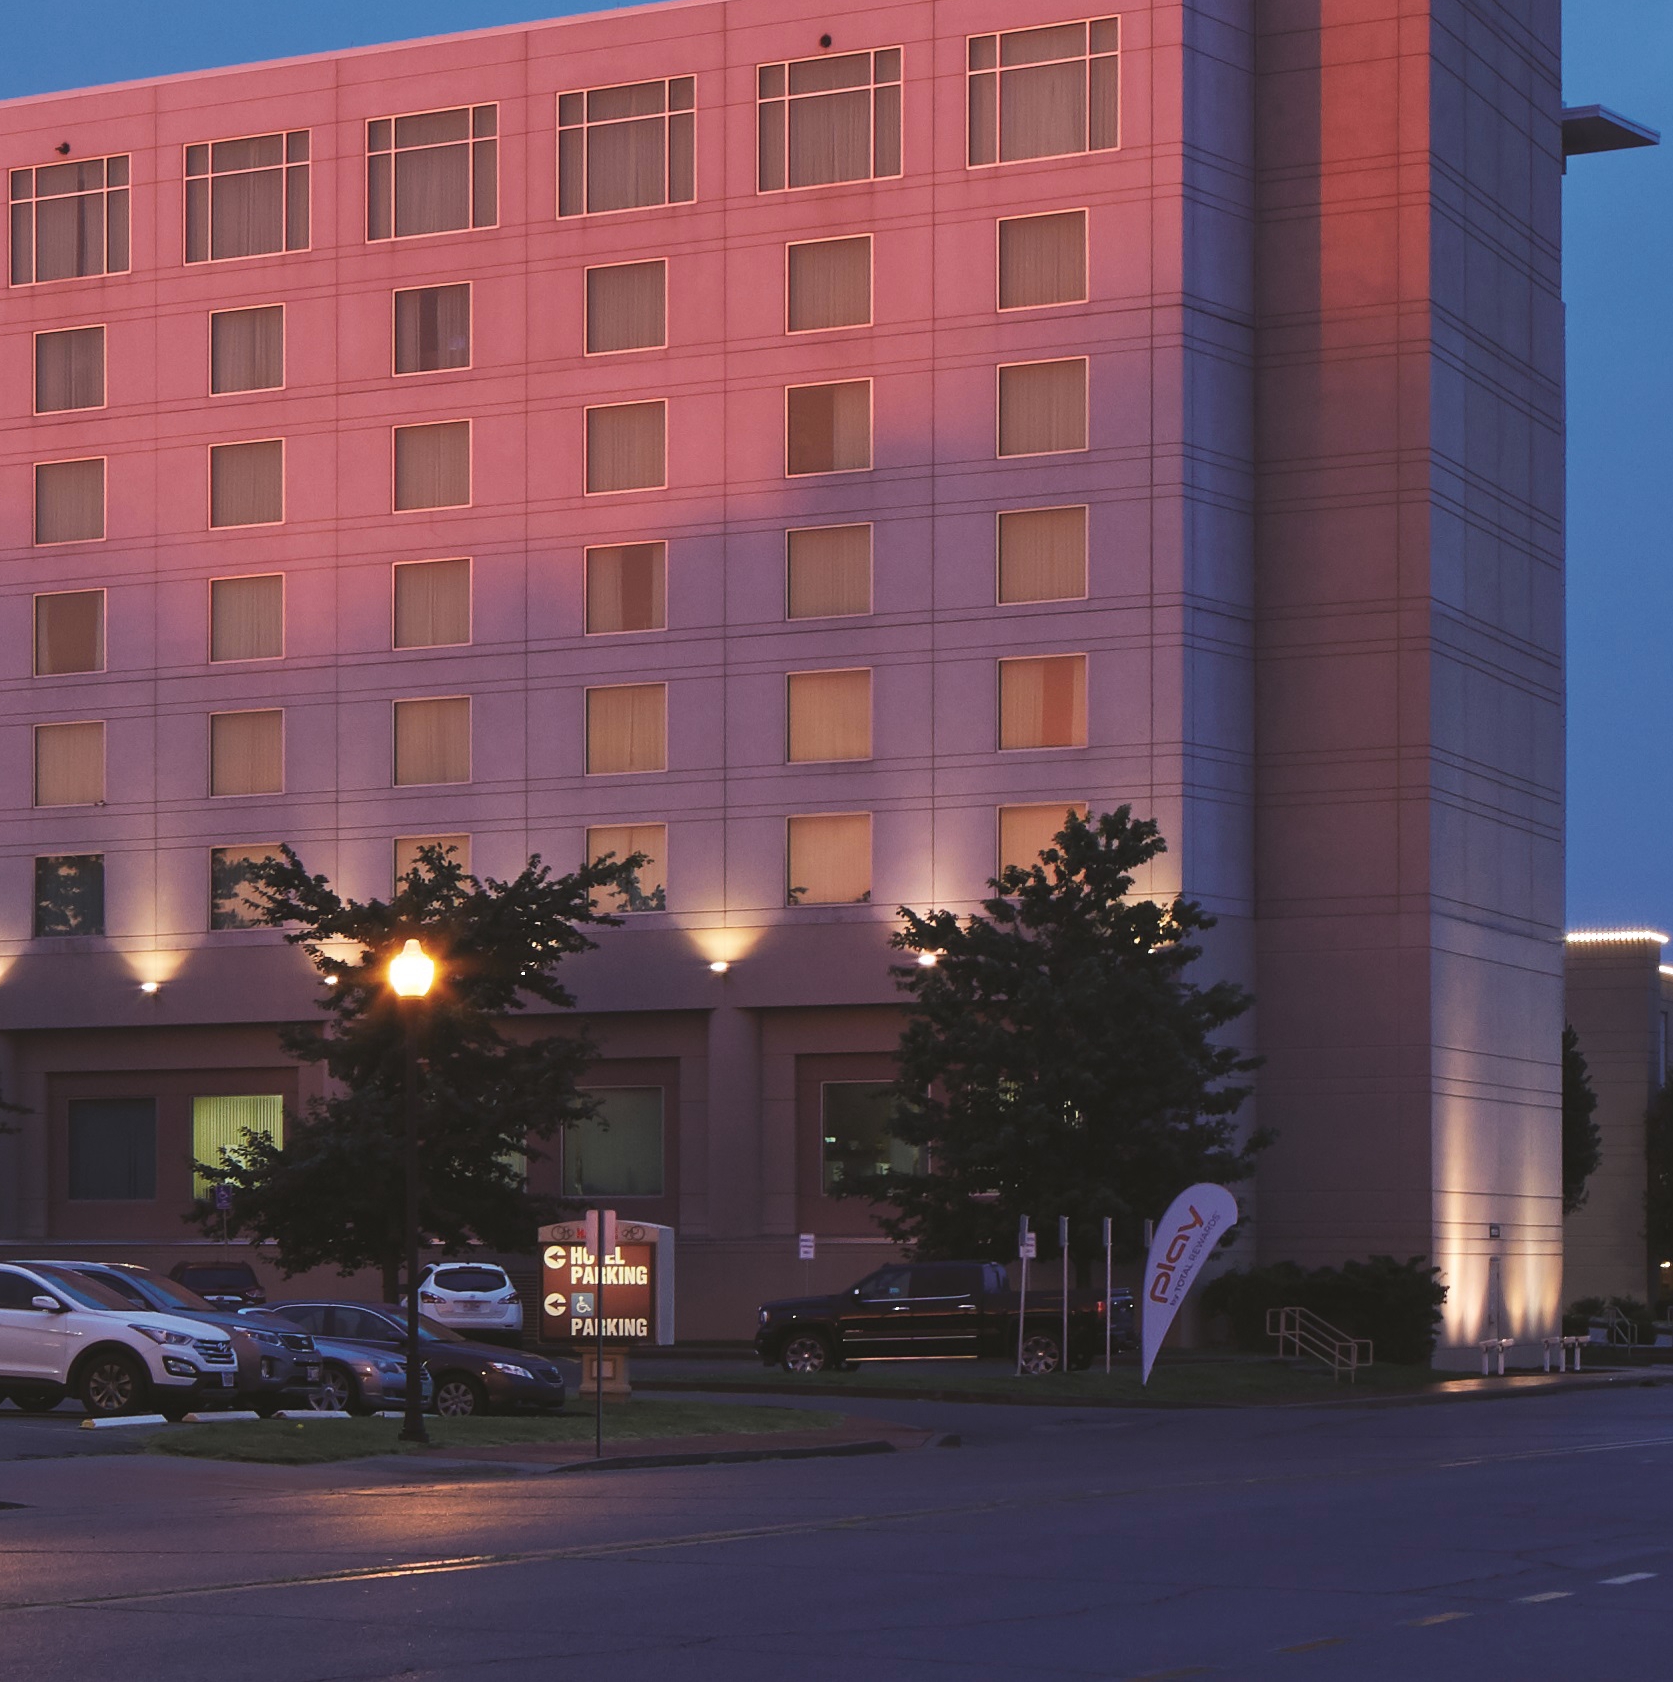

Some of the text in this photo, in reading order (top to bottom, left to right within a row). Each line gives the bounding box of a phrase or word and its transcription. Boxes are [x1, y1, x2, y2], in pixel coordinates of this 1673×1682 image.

[570, 1246, 626, 1265] HOEL
[1150, 1204, 1204, 1304] play
[1174, 1262, 1193, 1293] TOTAL
[1188, 1212, 1221, 1262] REWARDS
[570, 1266, 648, 1285] PARKING
[570, 1318, 648, 1336] PARKING
